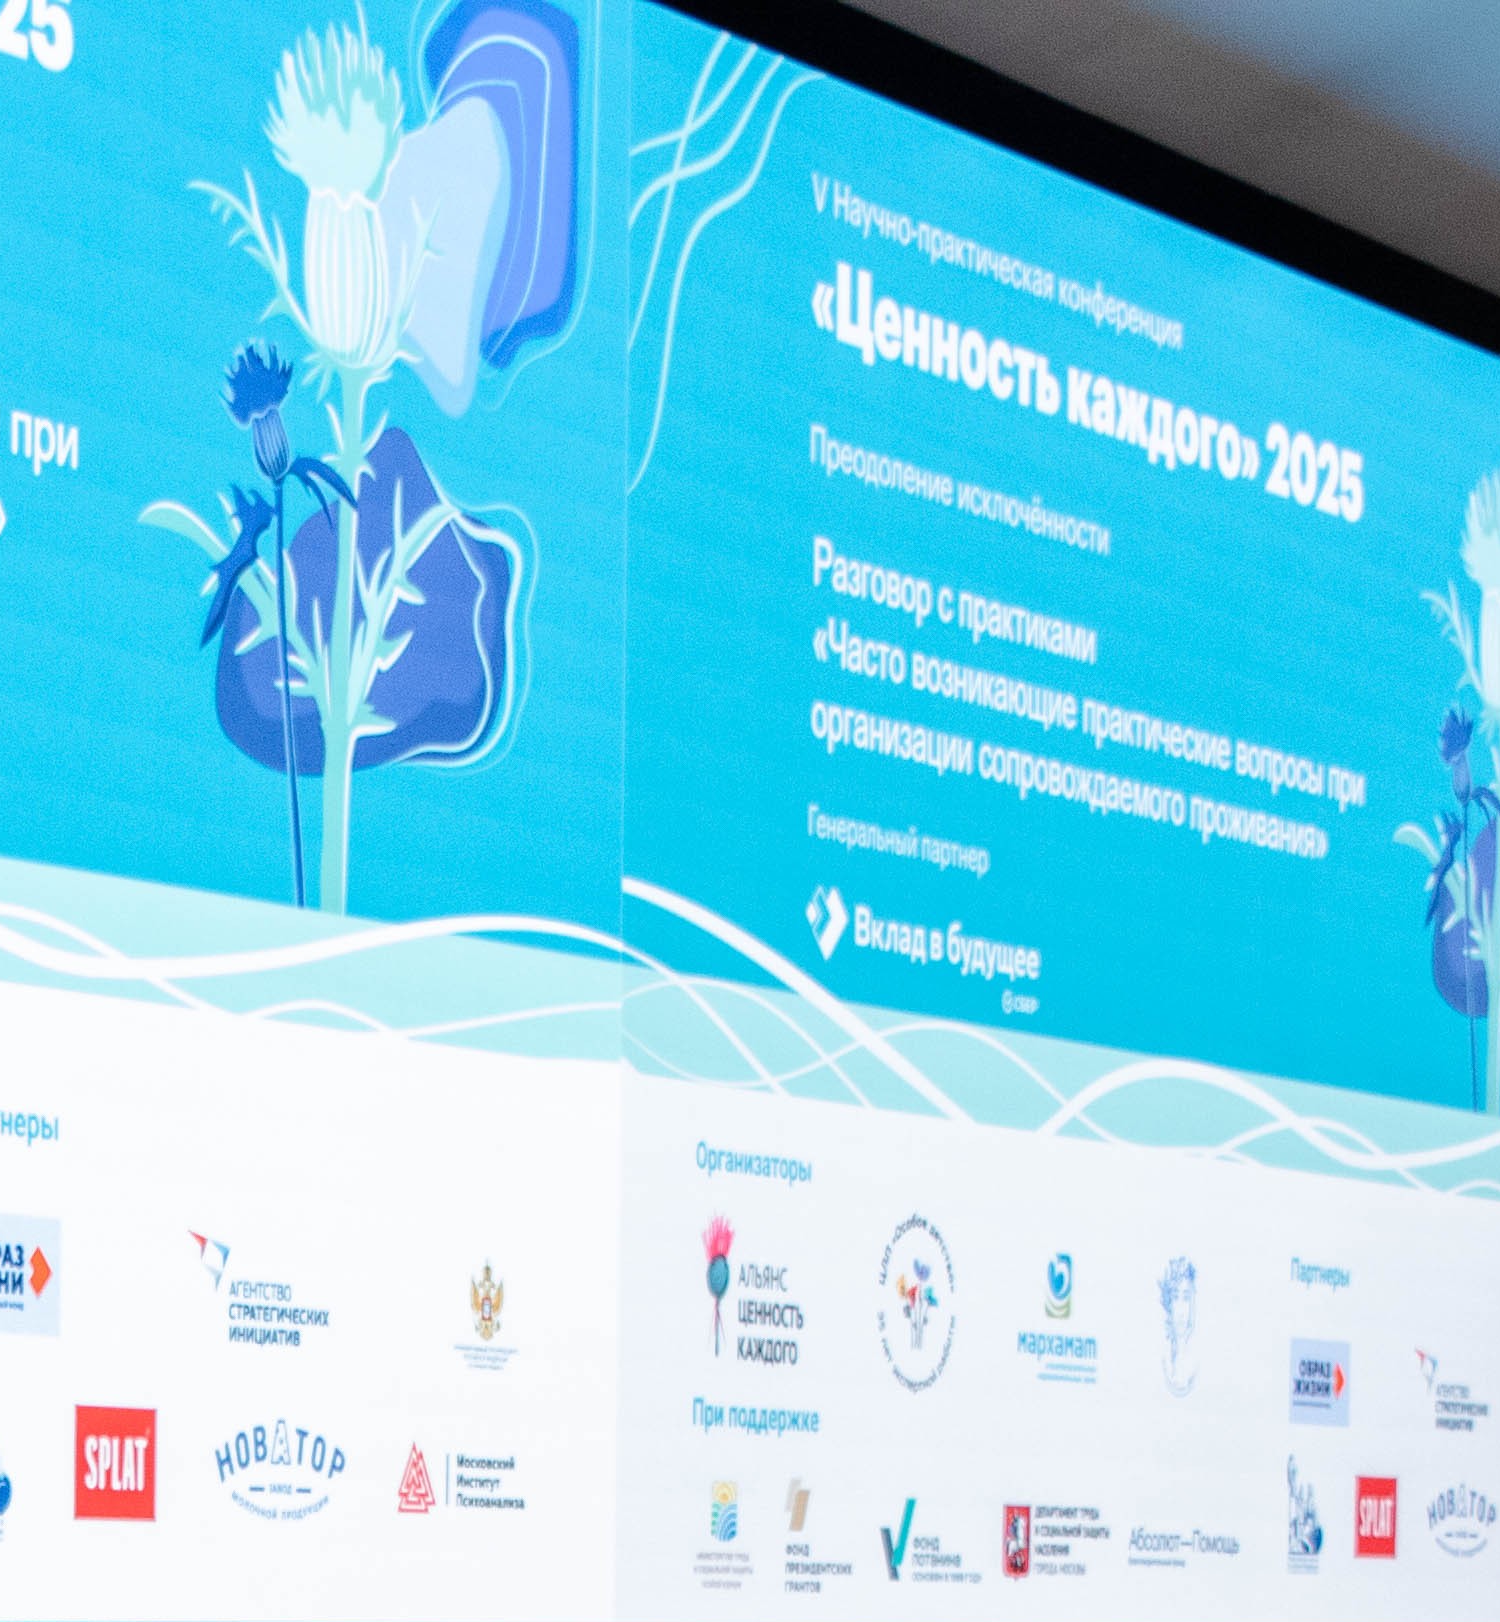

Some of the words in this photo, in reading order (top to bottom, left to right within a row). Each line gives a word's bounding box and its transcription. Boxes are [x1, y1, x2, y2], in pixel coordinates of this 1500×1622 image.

[811, 172, 829, 213] V
[833, 179, 1056, 301] Научно-практическая
[1058, 278, 1184, 350] конференция
[811, 261, 1062, 415] «Ценность
[1067, 366, 1261, 480] каждого»
[1265, 421, 1365, 523] 2025
[10, 410, 79, 476] при
[810, 422, 954, 506] Преодоление
[957, 482, 1111, 555] исключённости
[813, 535, 933, 628] Разговор
[937, 586, 954, 623] с
[958, 590, 1097, 664] практиками
[813, 616, 907, 684] «Часто
[911, 651, 1078, 731] возникающие
[1082, 697, 1233, 770] практические
[1235, 739, 1325, 796] вопросы
[1325, 765, 1366, 811] при
[811, 700, 974, 776] организации
[978, 742, 1187, 826] сопровождаемого
[1189, 794, 1329, 859] проживания»
[808, 802, 919, 858] Генеральный
[919, 835, 990, 878] партнер
[854, 904, 928, 964] Вклад
[928, 929, 944, 961] в
[946, 921, 1041, 981] будущее
[696, 1141, 812, 1186] Организаторы
[229, 1281, 291, 1302] АГЕНТСТВО
[739, 1264, 787, 1292] АЛЬЯНС
[1291, 1257, 1350, 1291] Партнеры
[229, 1304, 329, 1326] СТРАТЕГИЧЕСКИХ
[739, 1300, 803, 1329] ЦЕННОСТЬ
[229, 1327, 300, 1346] ИНИЦИАТИВ
[738, 1338, 797, 1365] КАЖДОГО
[1018, 1332, 1096, 1360] мархамат
[1293, 1377, 1331, 1399] ЖИЗНИ
[1299, 1359, 1332, 1379] ОБРАЗ
[693, 1397, 724, 1432] При
[729, 1406, 819, 1437] поддержке
[85, 1436, 146, 1492] SPLAT
[215, 1419, 346, 1483] НОВАТОР
[457, 1455, 515, 1469] Московский
[457, 1474, 500, 1492] Институт
[457, 1493, 525, 1509] Психоанализа
[1358, 1496, 1396, 1540] SPLAT
[1427, 1483, 1497, 1530] НОВАТОР
